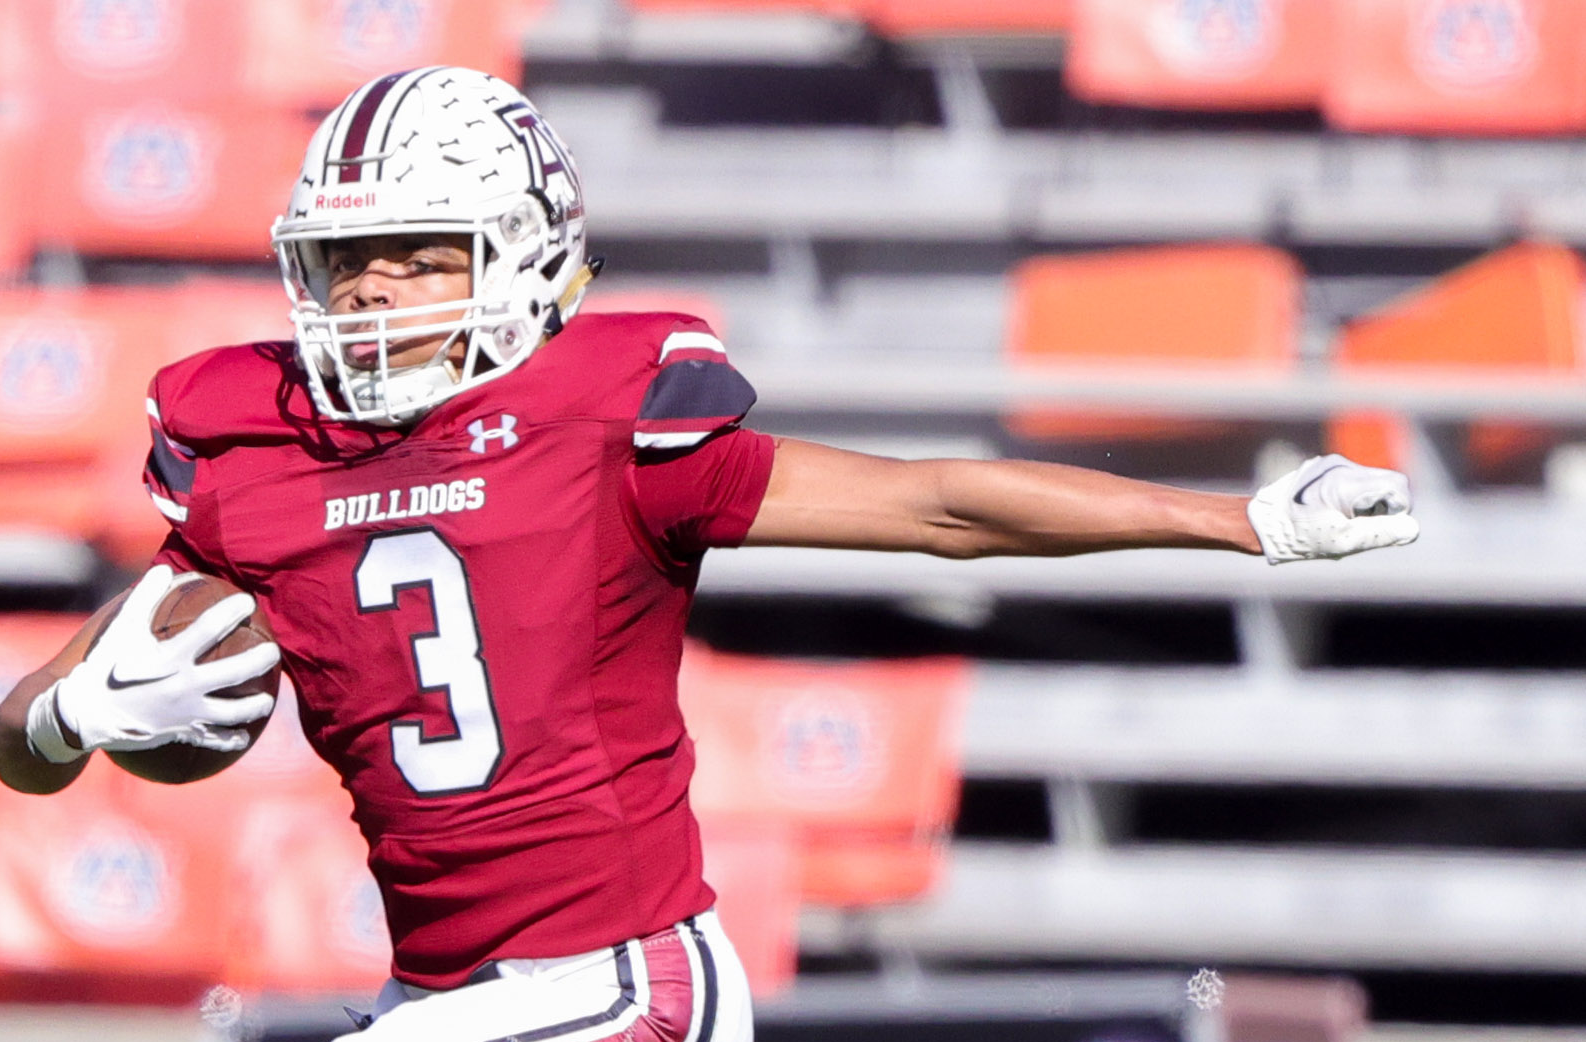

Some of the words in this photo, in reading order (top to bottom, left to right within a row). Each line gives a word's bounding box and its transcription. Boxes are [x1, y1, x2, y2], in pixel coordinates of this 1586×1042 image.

[316, 192, 376, 209] Riddell
[323, 477, 487, 531] BULLDOGS
[353, 525, 505, 797] 3
